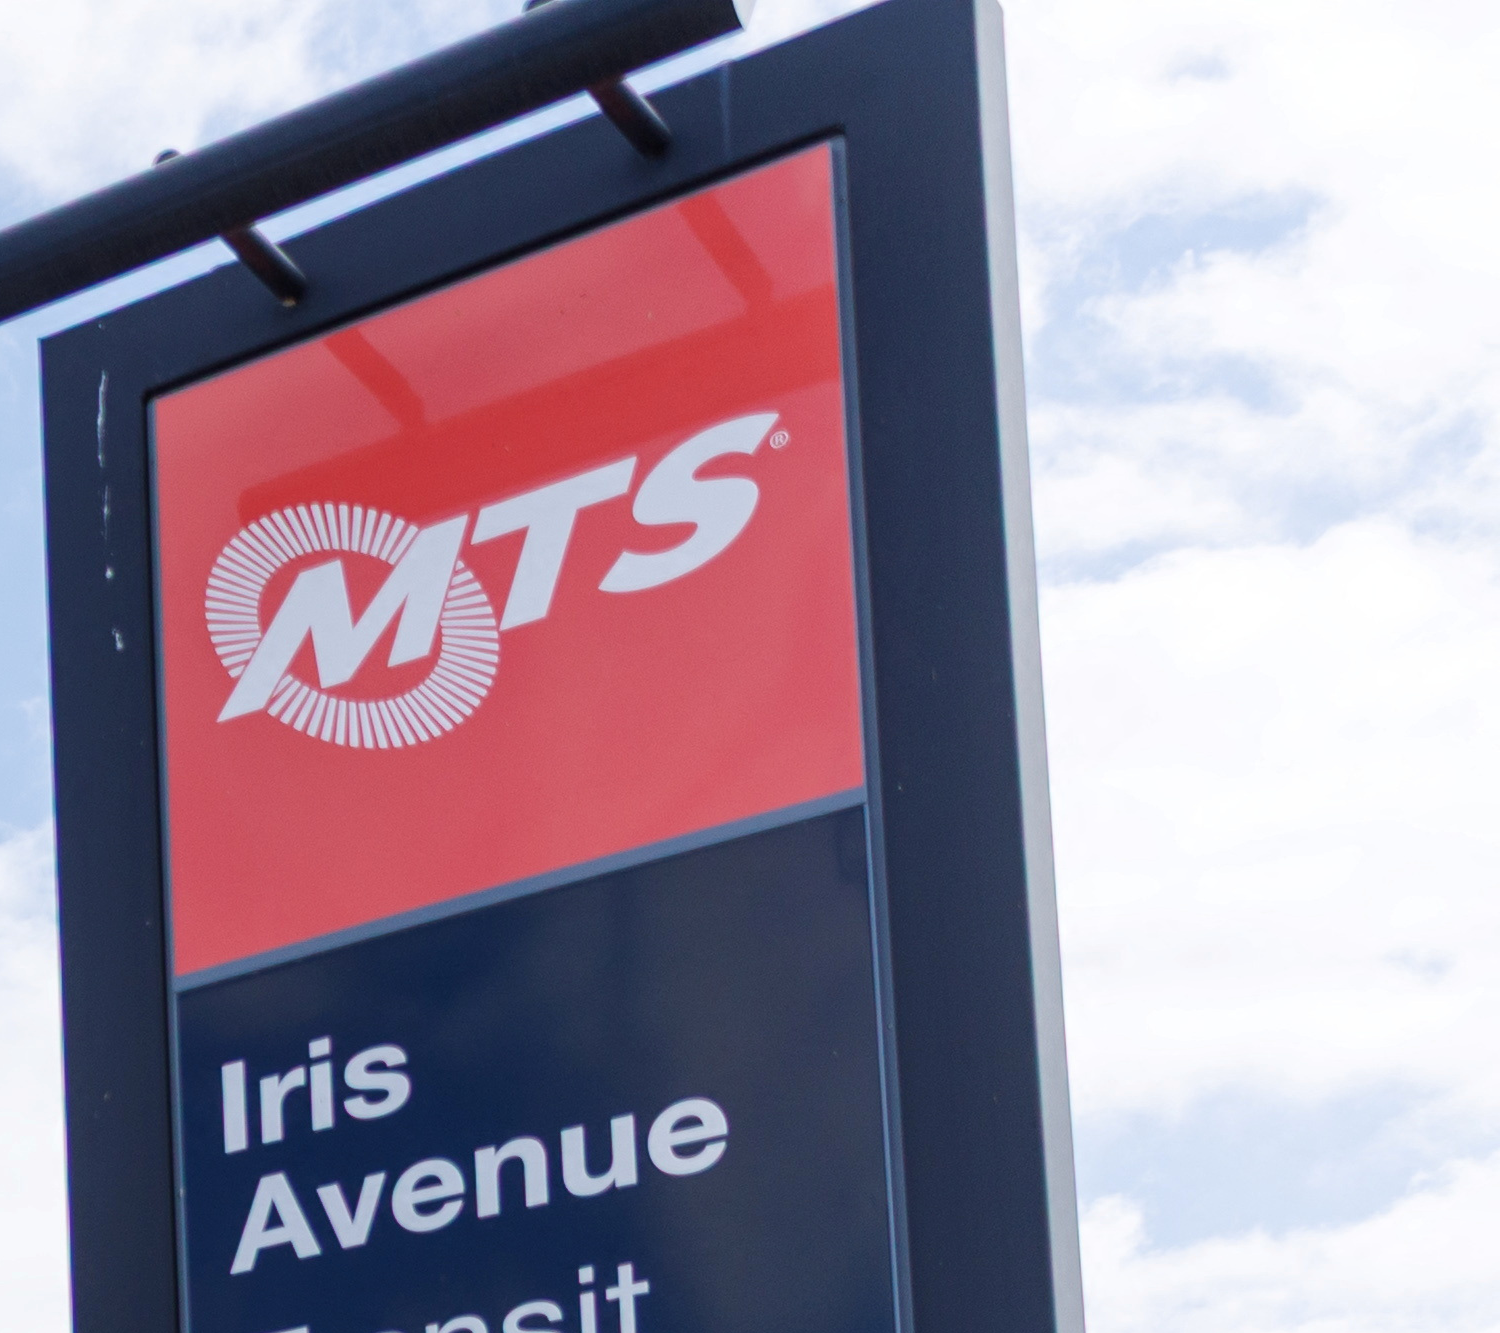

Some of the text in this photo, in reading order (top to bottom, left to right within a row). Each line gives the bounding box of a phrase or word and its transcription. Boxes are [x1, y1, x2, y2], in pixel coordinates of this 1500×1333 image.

[217, 411, 781, 725] MTS
[221, 1037, 411, 1154] Iris
[230, 1096, 729, 1276] Avenue
